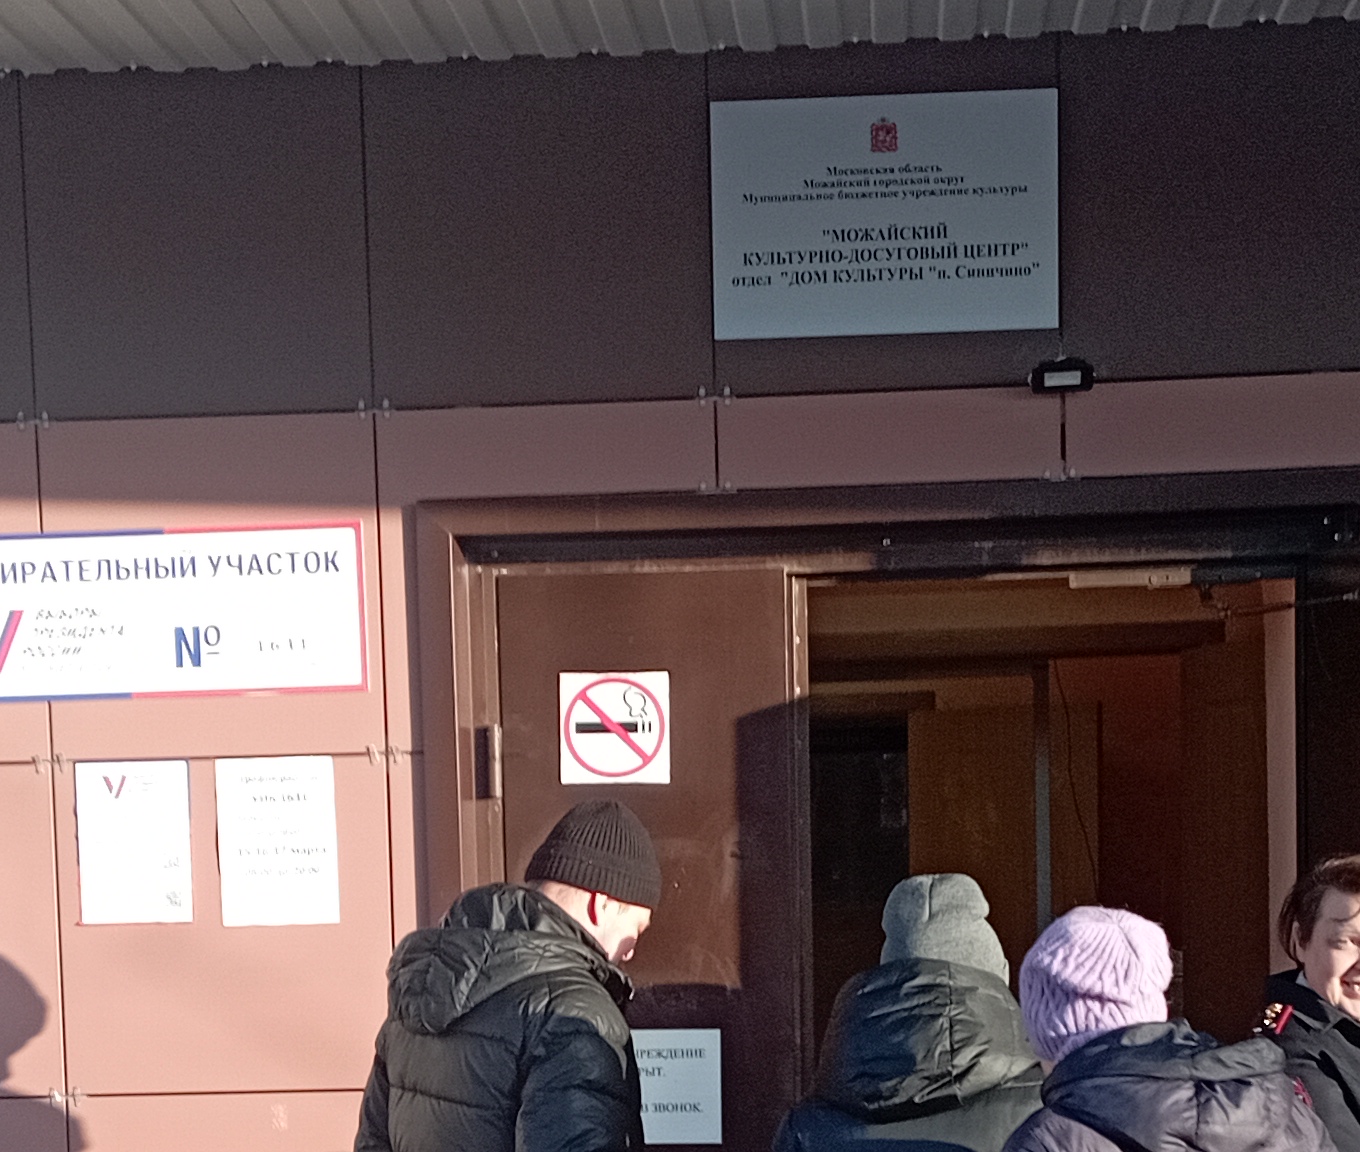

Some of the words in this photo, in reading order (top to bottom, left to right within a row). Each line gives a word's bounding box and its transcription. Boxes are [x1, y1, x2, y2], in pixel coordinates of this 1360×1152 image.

[826, 165, 895, 177] Московская
[897, 163, 943, 175] область
[803, 177, 870, 190] Можайский
[872, 176, 931, 189] городской
[933, 176, 965, 188] округ
[742, 191, 835, 205] Муниципальное
[837, 188, 900, 202] бюджетное
[901, 187, 970, 201] учреждение
[971, 184, 1029, 198] культуры
[822, 222, 948, 243] "МОЖАЙСКИЙ
[742, 242, 958, 267] КУЛЬТУРНО-ДОСУГОВЫЙ
[731, 275, 772, 288] отдел
[780, 269, 828, 288] "ДОМ
[833, 266, 925, 285] КУЛЬТУРЫ
[209, 550, 341, 579] УЧАСТОК
